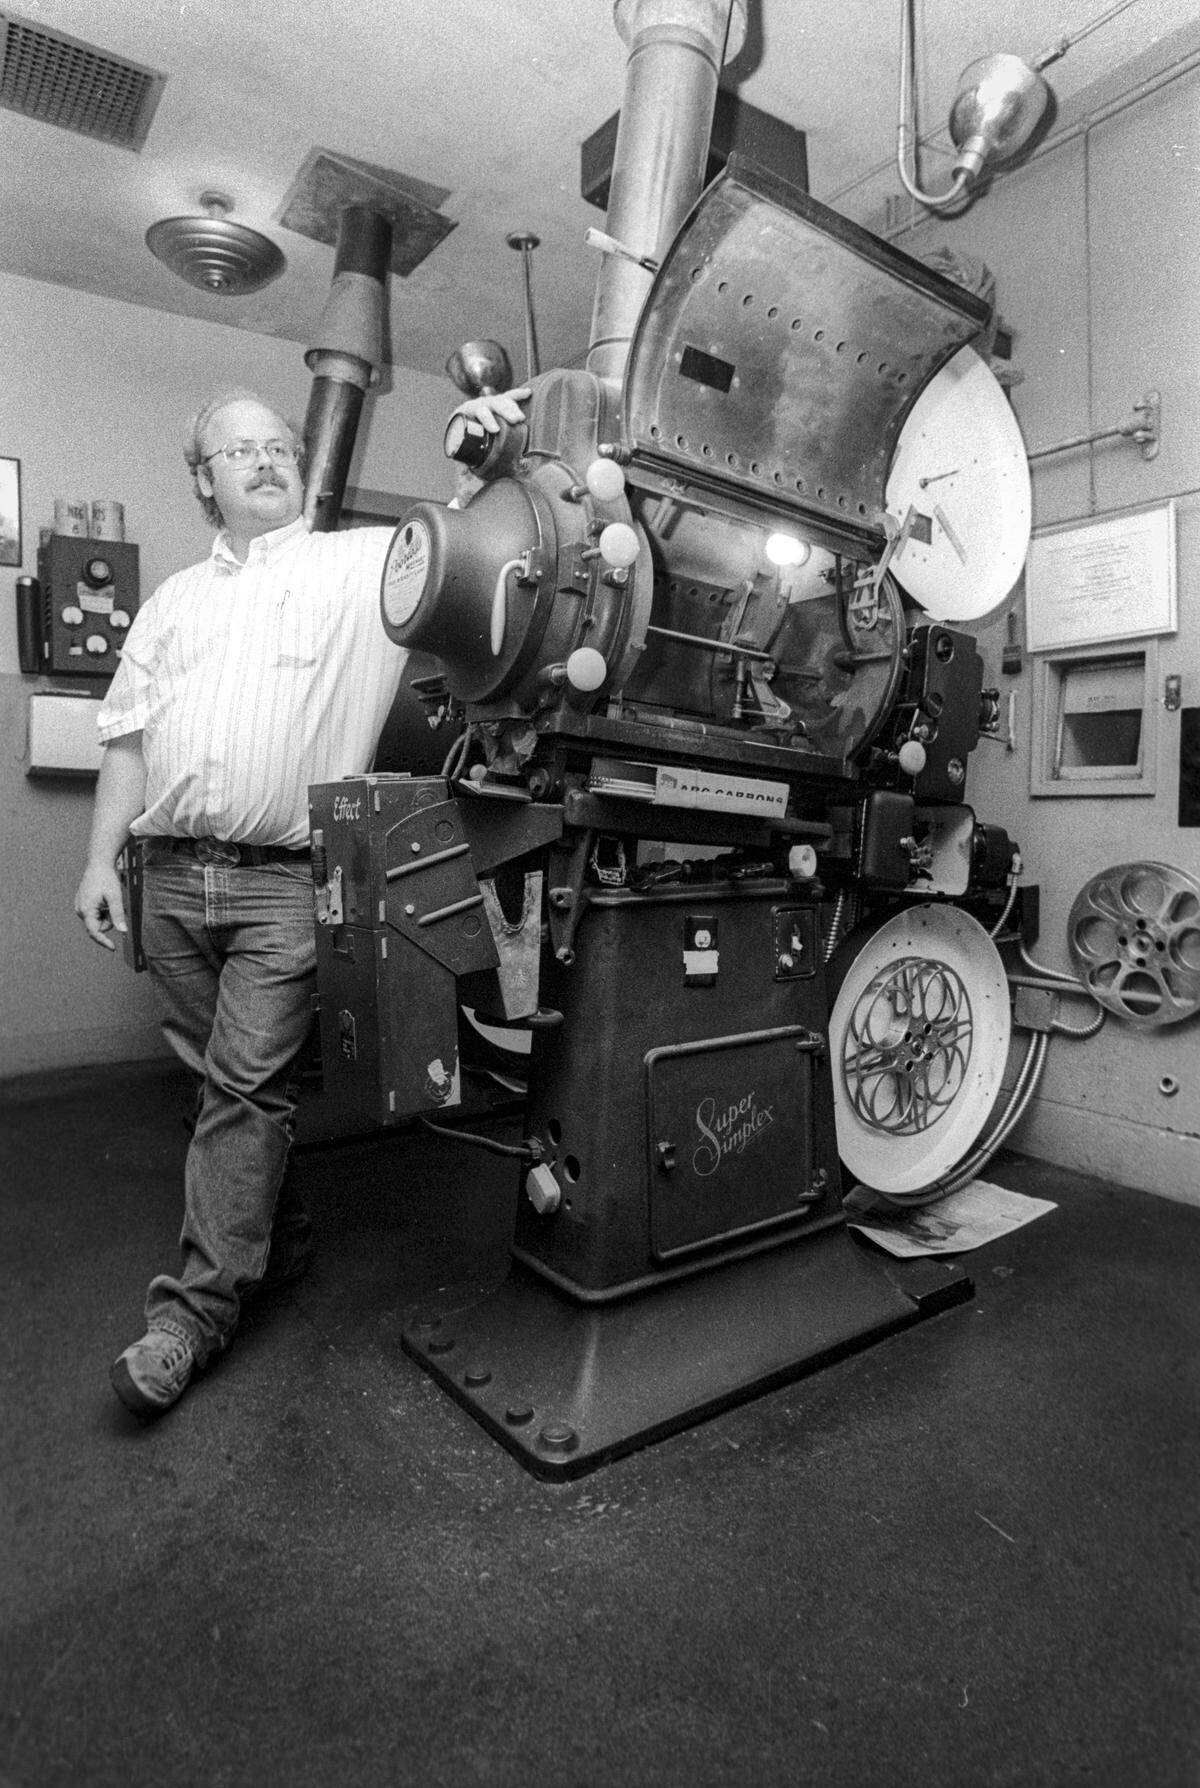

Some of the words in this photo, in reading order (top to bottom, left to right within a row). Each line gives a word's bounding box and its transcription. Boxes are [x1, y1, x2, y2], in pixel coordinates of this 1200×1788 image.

[333, 795, 362, 822] Effect
[692, 1105, 775, 1176] Simplex
[696, 1090, 756, 1142] Super
